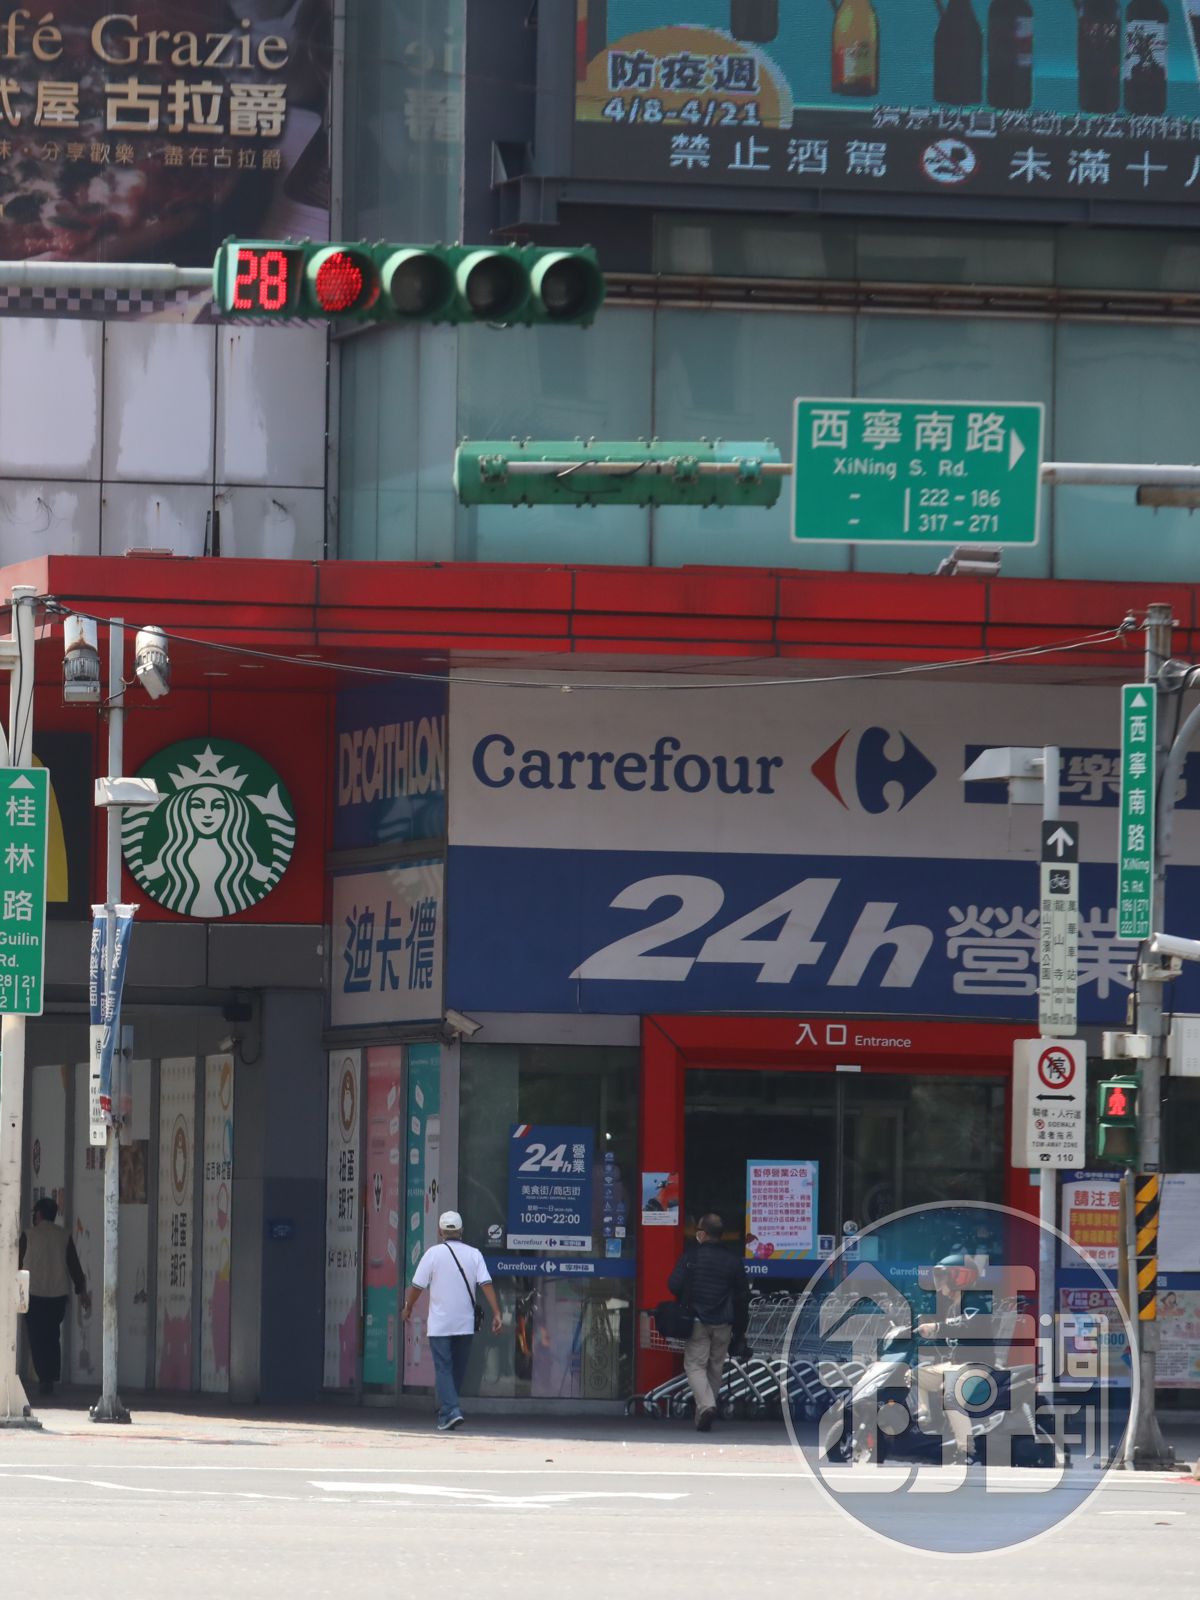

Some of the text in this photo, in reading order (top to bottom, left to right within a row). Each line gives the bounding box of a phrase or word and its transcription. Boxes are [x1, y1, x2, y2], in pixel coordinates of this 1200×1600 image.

[91, 14, 289, 71] Grazie
[608, 51, 760, 95] 防疫週
[104, 76, 288, 138] 古拉爵
[603, 97, 761, 126] 4/8-4/21
[670, 134, 887, 178] 禁止酒駕
[233, 249, 288, 311] 28
[810, 408, 1006, 453] 西寧南路
[833, 457, 969, 480] XiNing S. Rd.
[339, 714, 445, 807] DECATHLON
[471, 733, 784, 795] Carrefour
[1127, 715, 1148, 852] 西寧南路
[2, 795, 36, 923] 桂林路
[343, 896, 438, 994] 迪卡儂
[568, 874, 934, 988] 24h
[795, 1023, 912, 1048] 入口 Entrance
[1057, 1154, 1074, 1162] 110
[513, 1238, 543, 1246] Carrefour
[497, 1262, 537, 1271] Carrefour
[889, 1266, 930, 1276] Carrefour
